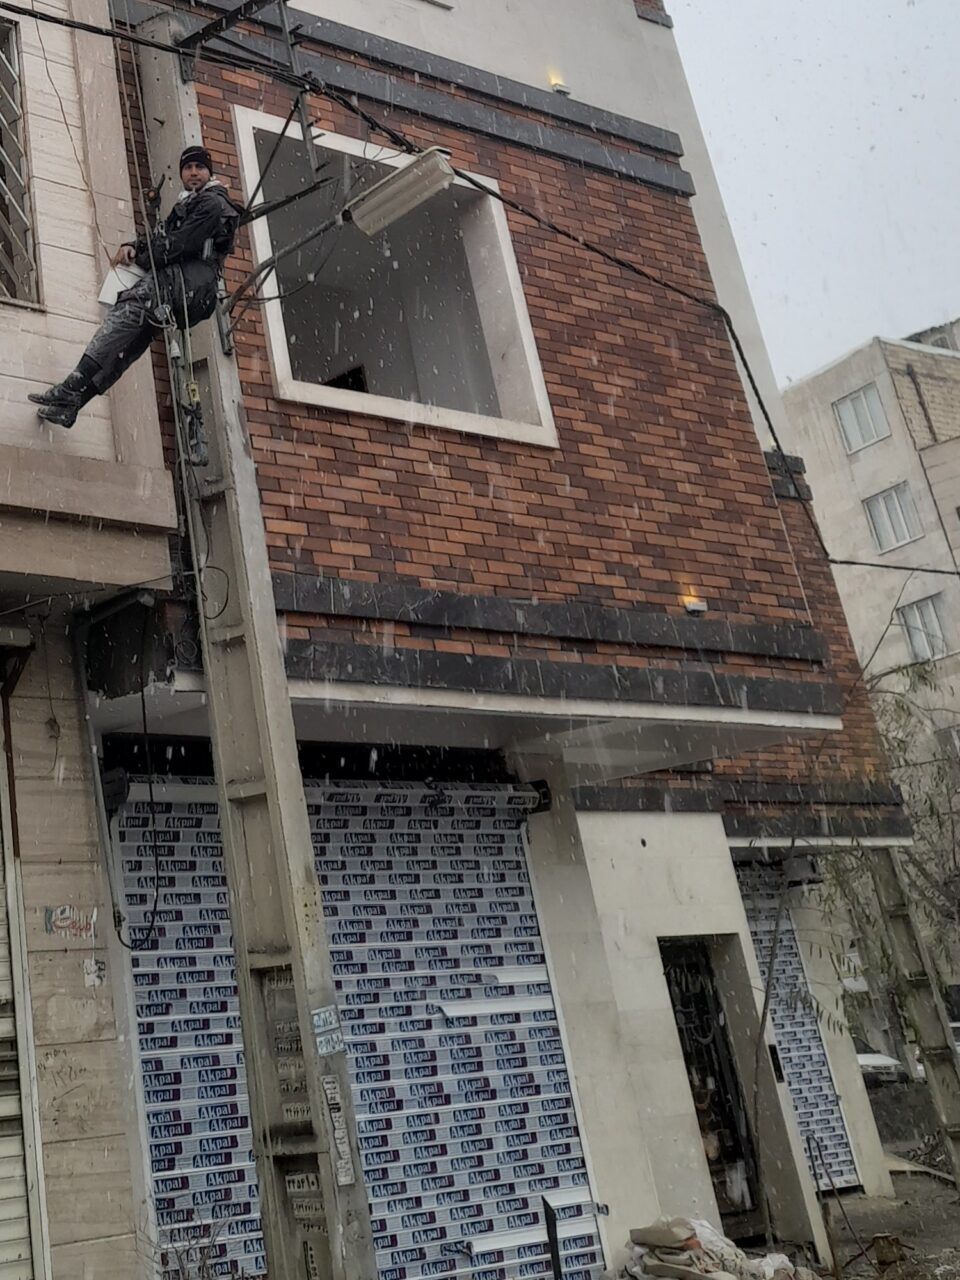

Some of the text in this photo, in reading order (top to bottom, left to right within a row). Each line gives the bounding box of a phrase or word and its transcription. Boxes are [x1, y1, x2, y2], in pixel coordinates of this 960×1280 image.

[318, 819, 344, 829] Akpal
[192, 846, 222, 857] Akpal
[342, 847, 367, 856] Akpal
[388, 847, 413, 856] Akpal
[432, 847, 456, 856] Akpal
[475, 847, 498, 856] Akpal
[161, 861, 189, 871] Akpal
[316, 861, 341, 871] Akpal
[362, 861, 387, 870] Akpal
[408, 861, 432, 870] Akpal
[452, 861, 475, 870] Akpal
[494, 861, 516, 870] Akpal
[193, 876, 223, 887] Akpal
[344, 875, 370, 885] Akpal
[390, 874, 415, 884] Akpal
[435, 874, 459, 884] Akpal
[365, 890, 391, 900] Akpal
[411, 890, 435, 900] Akpal
[455, 889, 478, 898] Akpal
[497, 888, 519, 897] Akpal
[165, 894, 194, 904] Akpal
[354, 905, 381, 916] Akpal
[402, 905, 427, 914] Akpal
[447, 903, 471, 913] Akpal
[491, 902, 514, 912] Akpal
[340, 920, 366, 930] Akpal
[388, 919, 414, 928] Akpal
[434, 917, 459, 926] Akpal
[478, 916, 502, 925] Akpal
[184, 924, 214, 935] Akpal
[428, 930, 453, 940] Akpal
[472, 928, 496, 939] Akpal
[334, 933, 360, 944] Akpal
[381, 932, 407, 942] Akpal
[177, 938, 207, 950] Akpal
[462, 945, 486, 954] Akpal
[506, 942, 530, 952] Akpal
[370, 950, 395, 960] Akpal
[416, 947, 442, 958] Akpal
[158, 957, 190, 968] Akpal
[430, 959, 455, 970] Akpal
[475, 957, 499, 967] Akpal
[518, 954, 541, 965] Akpal
[335, 964, 362, 975] Akpal
[383, 961, 409, 972] Akpal
[178, 971, 208, 984] Akpal
[358, 978, 385, 989] Akpal
[406, 976, 431, 986] Akpal
[451, 974, 476, 984] Akpal
[150, 989, 180, 1000] Akpal
[204, 986, 234, 998] Akpal
[395, 991, 421, 1002] Akpal
[441, 989, 466, 1000] Akpal
[486, 986, 510, 997] Akpal
[347, 993, 374, 1005] Akpal
[191, 1002, 221, 1014] Akpal
[380, 1006, 407, 1018] Akpal
[491, 1013, 516, 1025] Akpal
[173, 1019, 203, 1032] Akpal
[353, 1024, 380, 1036] Akpal
[401, 1020, 427, 1032] Akpal
[486, 1032, 511, 1042] Akpal
[530, 1026, 553, 1038] Akpal
[141, 1037, 171, 1050] Akpal
[196, 1034, 226, 1047] Akpal
[393, 1039, 419, 1051] Akpal
[440, 1034, 466, 1047] Akpal
[452, 1048, 477, 1060] Akpal
[496, 1044, 521, 1054] Akpal
[182, 1056, 213, 1068] Akpal
[357, 1055, 384, 1068] Akpal
[405, 1051, 431, 1062] Akpal
[453, 1062, 478, 1074] Akpal
[498, 1058, 522, 1070] Akpal
[200, 1068, 231, 1082] Akpal
[358, 1070, 385, 1084] Akpal
[406, 1066, 432, 1079] Akpal
[144, 1073, 175, 1087] Akpal
[459, 1078, 485, 1091] Akpal
[505, 1074, 529, 1086] Akpal
[200, 1084, 230, 1099] Akpal
[362, 1088, 389, 1101] Akpal
[411, 1083, 438, 1096] Akpal
[511, 1085, 536, 1098] Akpal
[419, 1094, 446, 1108] Akpal
[466, 1090, 491, 1103] Akpal
[370, 1100, 398, 1114] Akpal
[500, 1103, 524, 1116] Akpal
[543, 1098, 566, 1111] Akpal
[200, 1104, 232, 1118] Akpal
[455, 1108, 480, 1122] Akpal
[210, 1116, 241, 1132] Akpal
[360, 1119, 387, 1132] Akpal
[408, 1114, 434, 1127] Akpal
[496, 1119, 521, 1131] Akpal
[540, 1114, 563, 1126] Akpal
[153, 1123, 185, 1139] Akpal
[404, 1130, 430, 1144] Akpal
[451, 1124, 476, 1138] Akpal
[551, 1126, 574, 1138] Akpal
[201, 1136, 232, 1152] Akpal
[462, 1139, 488, 1151] Akpal
[508, 1133, 532, 1147] Akpal
[415, 1144, 442, 1157] Akpal
[498, 1150, 523, 1161] Akpal
[542, 1144, 566, 1157] Akpal
[194, 1153, 225, 1168] Akpal
[367, 1151, 393, 1166] Akpal
[452, 1156, 478, 1169] Akpal
[558, 1157, 582, 1170] Akpal
[405, 1162, 432, 1176] Akpal
[515, 1164, 539, 1176] Akpal
[208, 1170, 239, 1186] Akpal
[470, 1170, 495, 1182] Akpal
[374, 1182, 401, 1197] Akpal
[423, 1176, 449, 1191] Akpal
[530, 1177, 554, 1190] Akpal
[438, 1190, 464, 1202] Akpal
[485, 1184, 510, 1196] Akpal
[194, 1188, 225, 1206] Akpal
[213, 1202, 244, 1219] Akpal
[389, 1197, 416, 1212] Akpal
[498, 1198, 523, 1211] Akpal
[451, 1205, 478, 1218] Akpal
[403, 1212, 430, 1228] Akpal
[509, 1214, 533, 1228] Akpal
[229, 1220, 260, 1234] Akpal
[462, 1220, 488, 1236] Akpal
[414, 1228, 441, 1243] Akpal
[564, 1237, 589, 1250] Akpal
[393, 1248, 420, 1265] Akpal
[520, 1244, 544, 1258] Akpal
[471, 1253, 497, 1268] Akpal
[566, 1253, 591, 1268] Akpal
[423, 1260, 450, 1276] Akpal
[521, 1263, 545, 1276] Akpal
